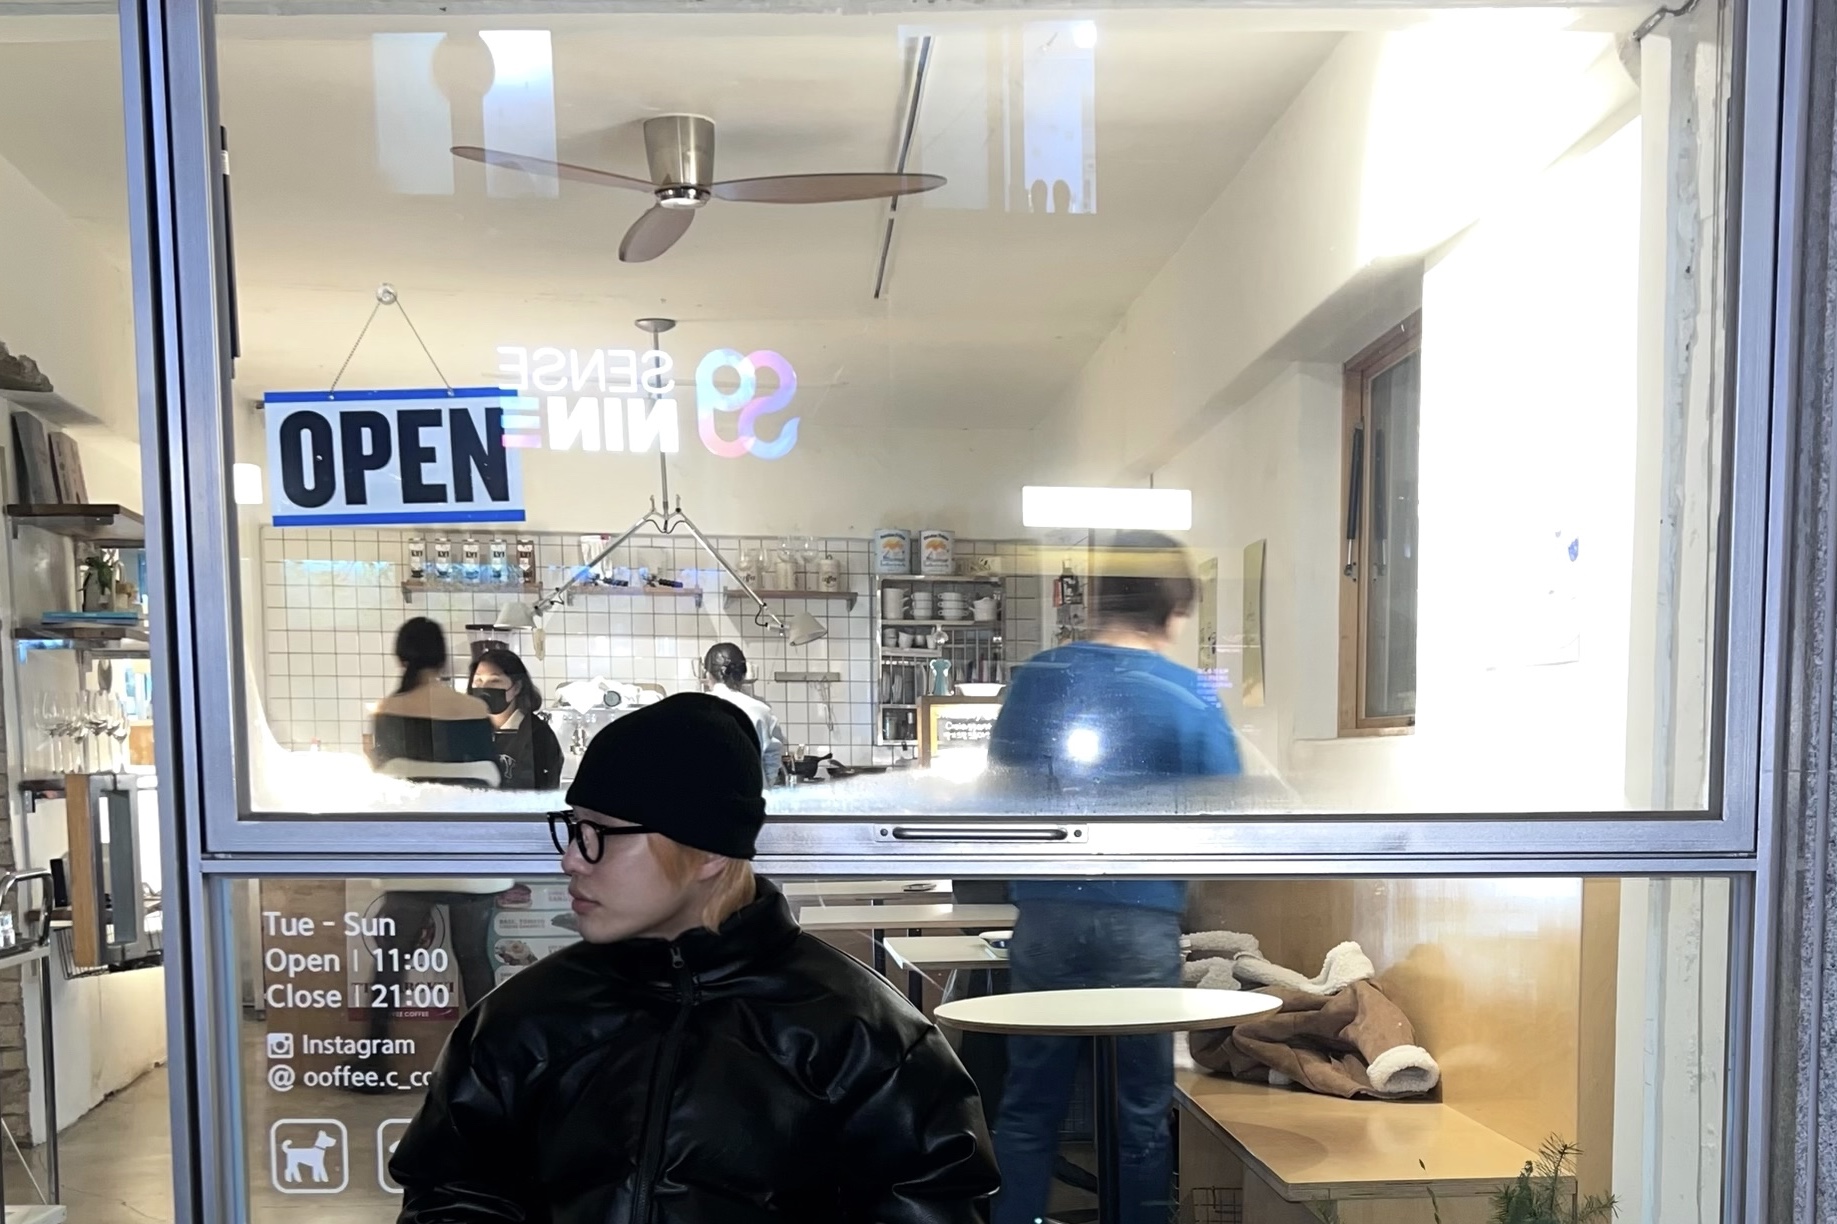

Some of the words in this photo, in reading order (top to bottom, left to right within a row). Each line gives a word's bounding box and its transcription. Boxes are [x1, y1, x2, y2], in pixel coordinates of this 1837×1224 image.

[279, 406, 511, 509] OPEN
[262, 911, 314, 937] Tue
[344, 911, 396, 937] Sun
[264, 947, 341, 977] Open
[372, 948, 449, 972] 11:00
[264, 984, 342, 1008] Close
[371, 984, 450, 1008] 21:00
[302, 1033, 416, 1059] Instagram
[267, 1064, 296, 1092] @
